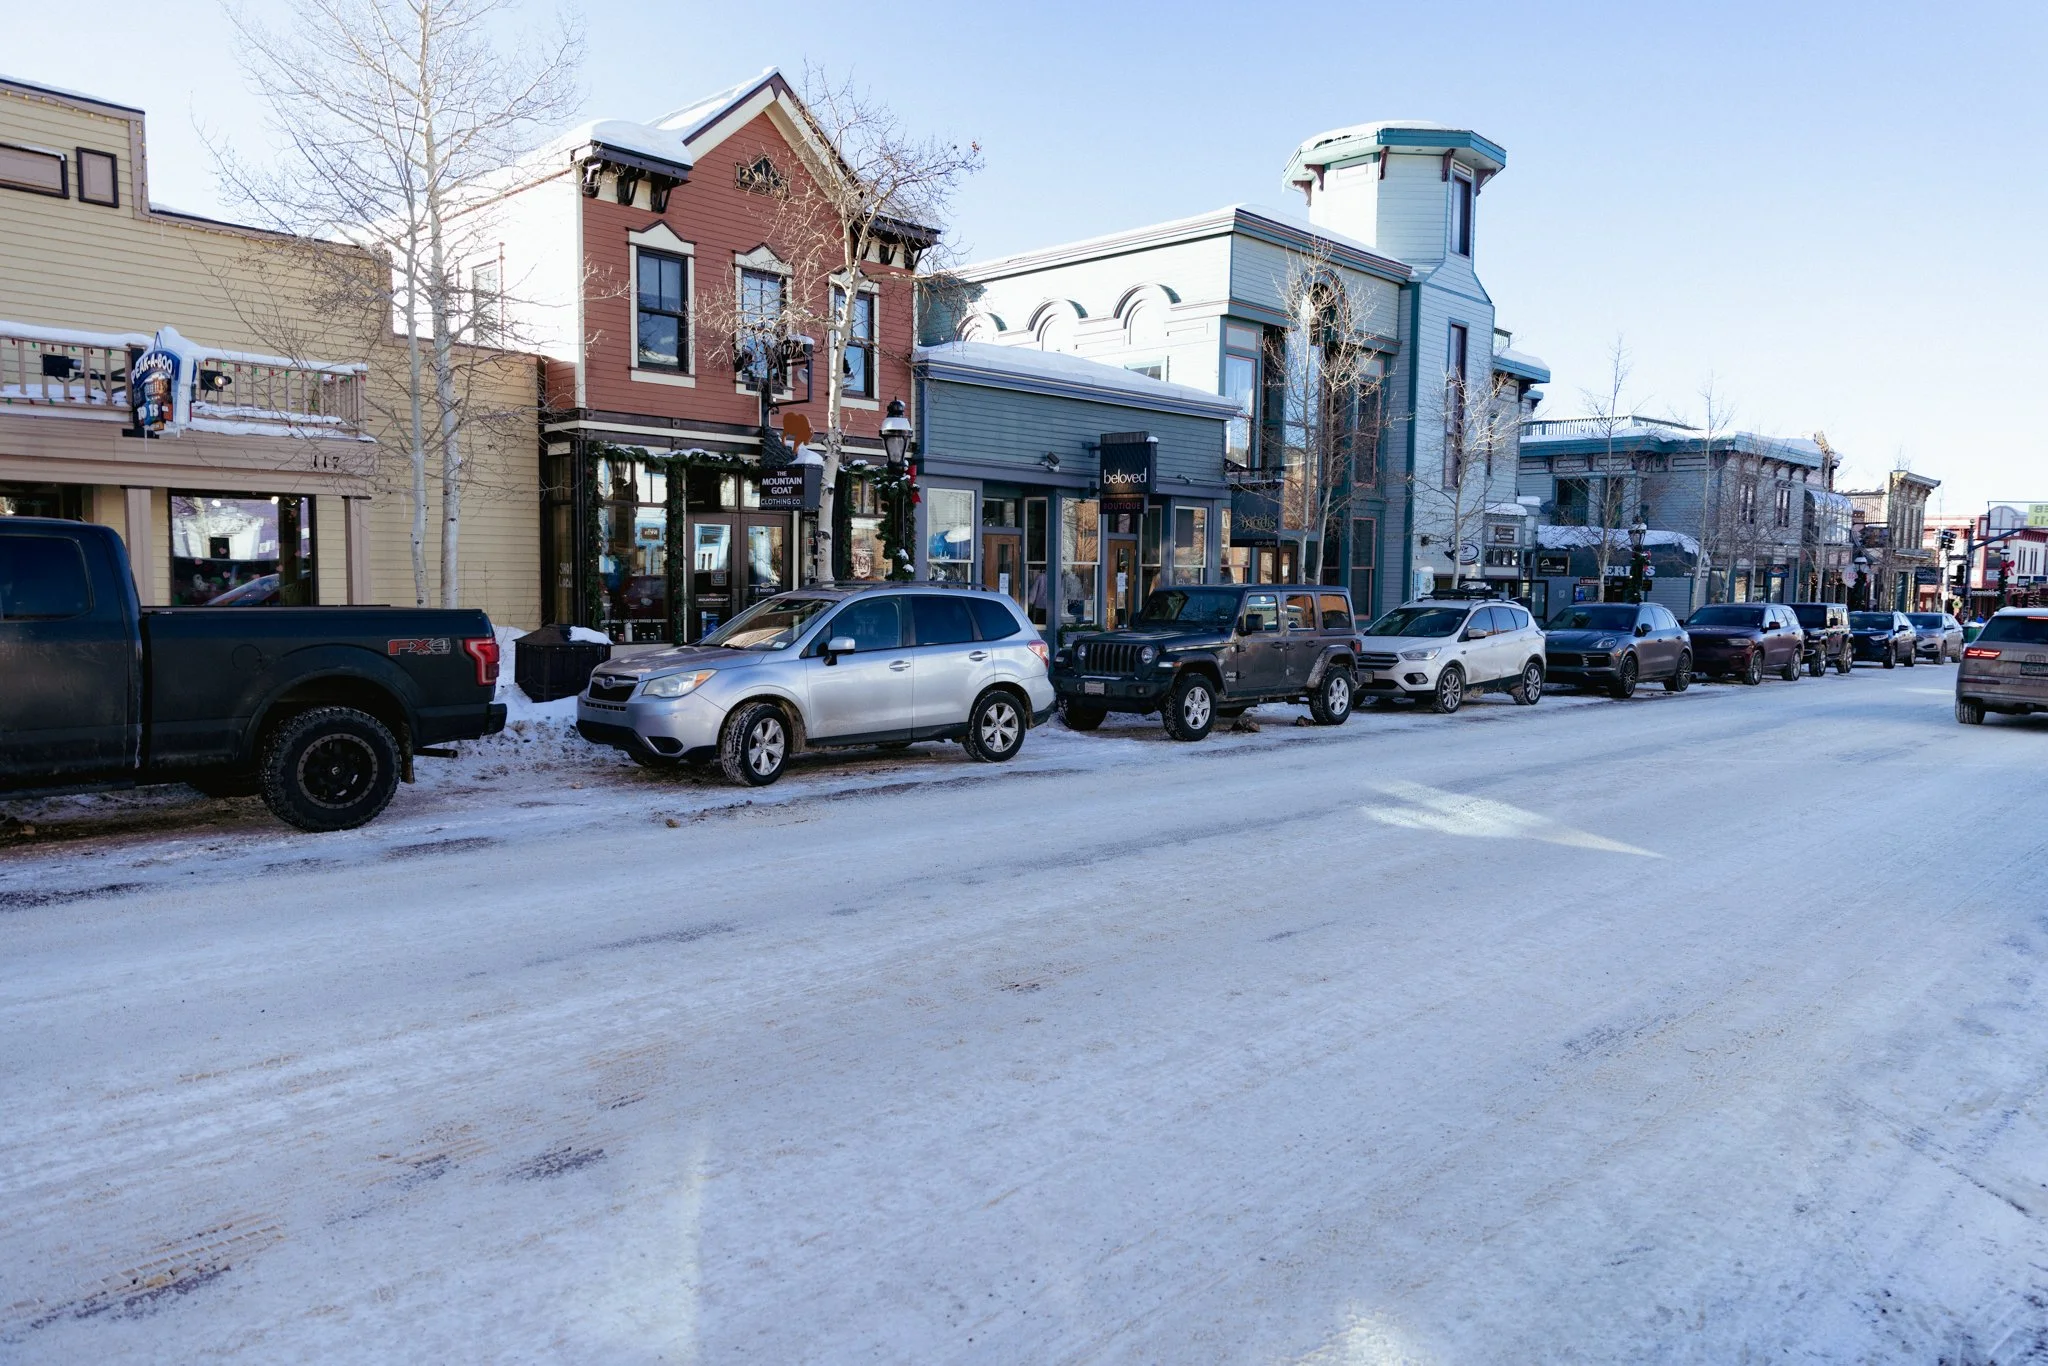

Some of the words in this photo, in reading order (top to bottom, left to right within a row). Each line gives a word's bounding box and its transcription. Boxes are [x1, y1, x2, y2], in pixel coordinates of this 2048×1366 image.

[131, 353, 173, 384] PEAK-A-BOO
[762, 477, 803, 485] MOUNTAIN
[1103, 467, 1147, 484] beloved
[771, 486, 793, 494] GOAT
[1104, 502, 1141, 510] BOUTIQUE
[388, 637, 451, 655] FX4
